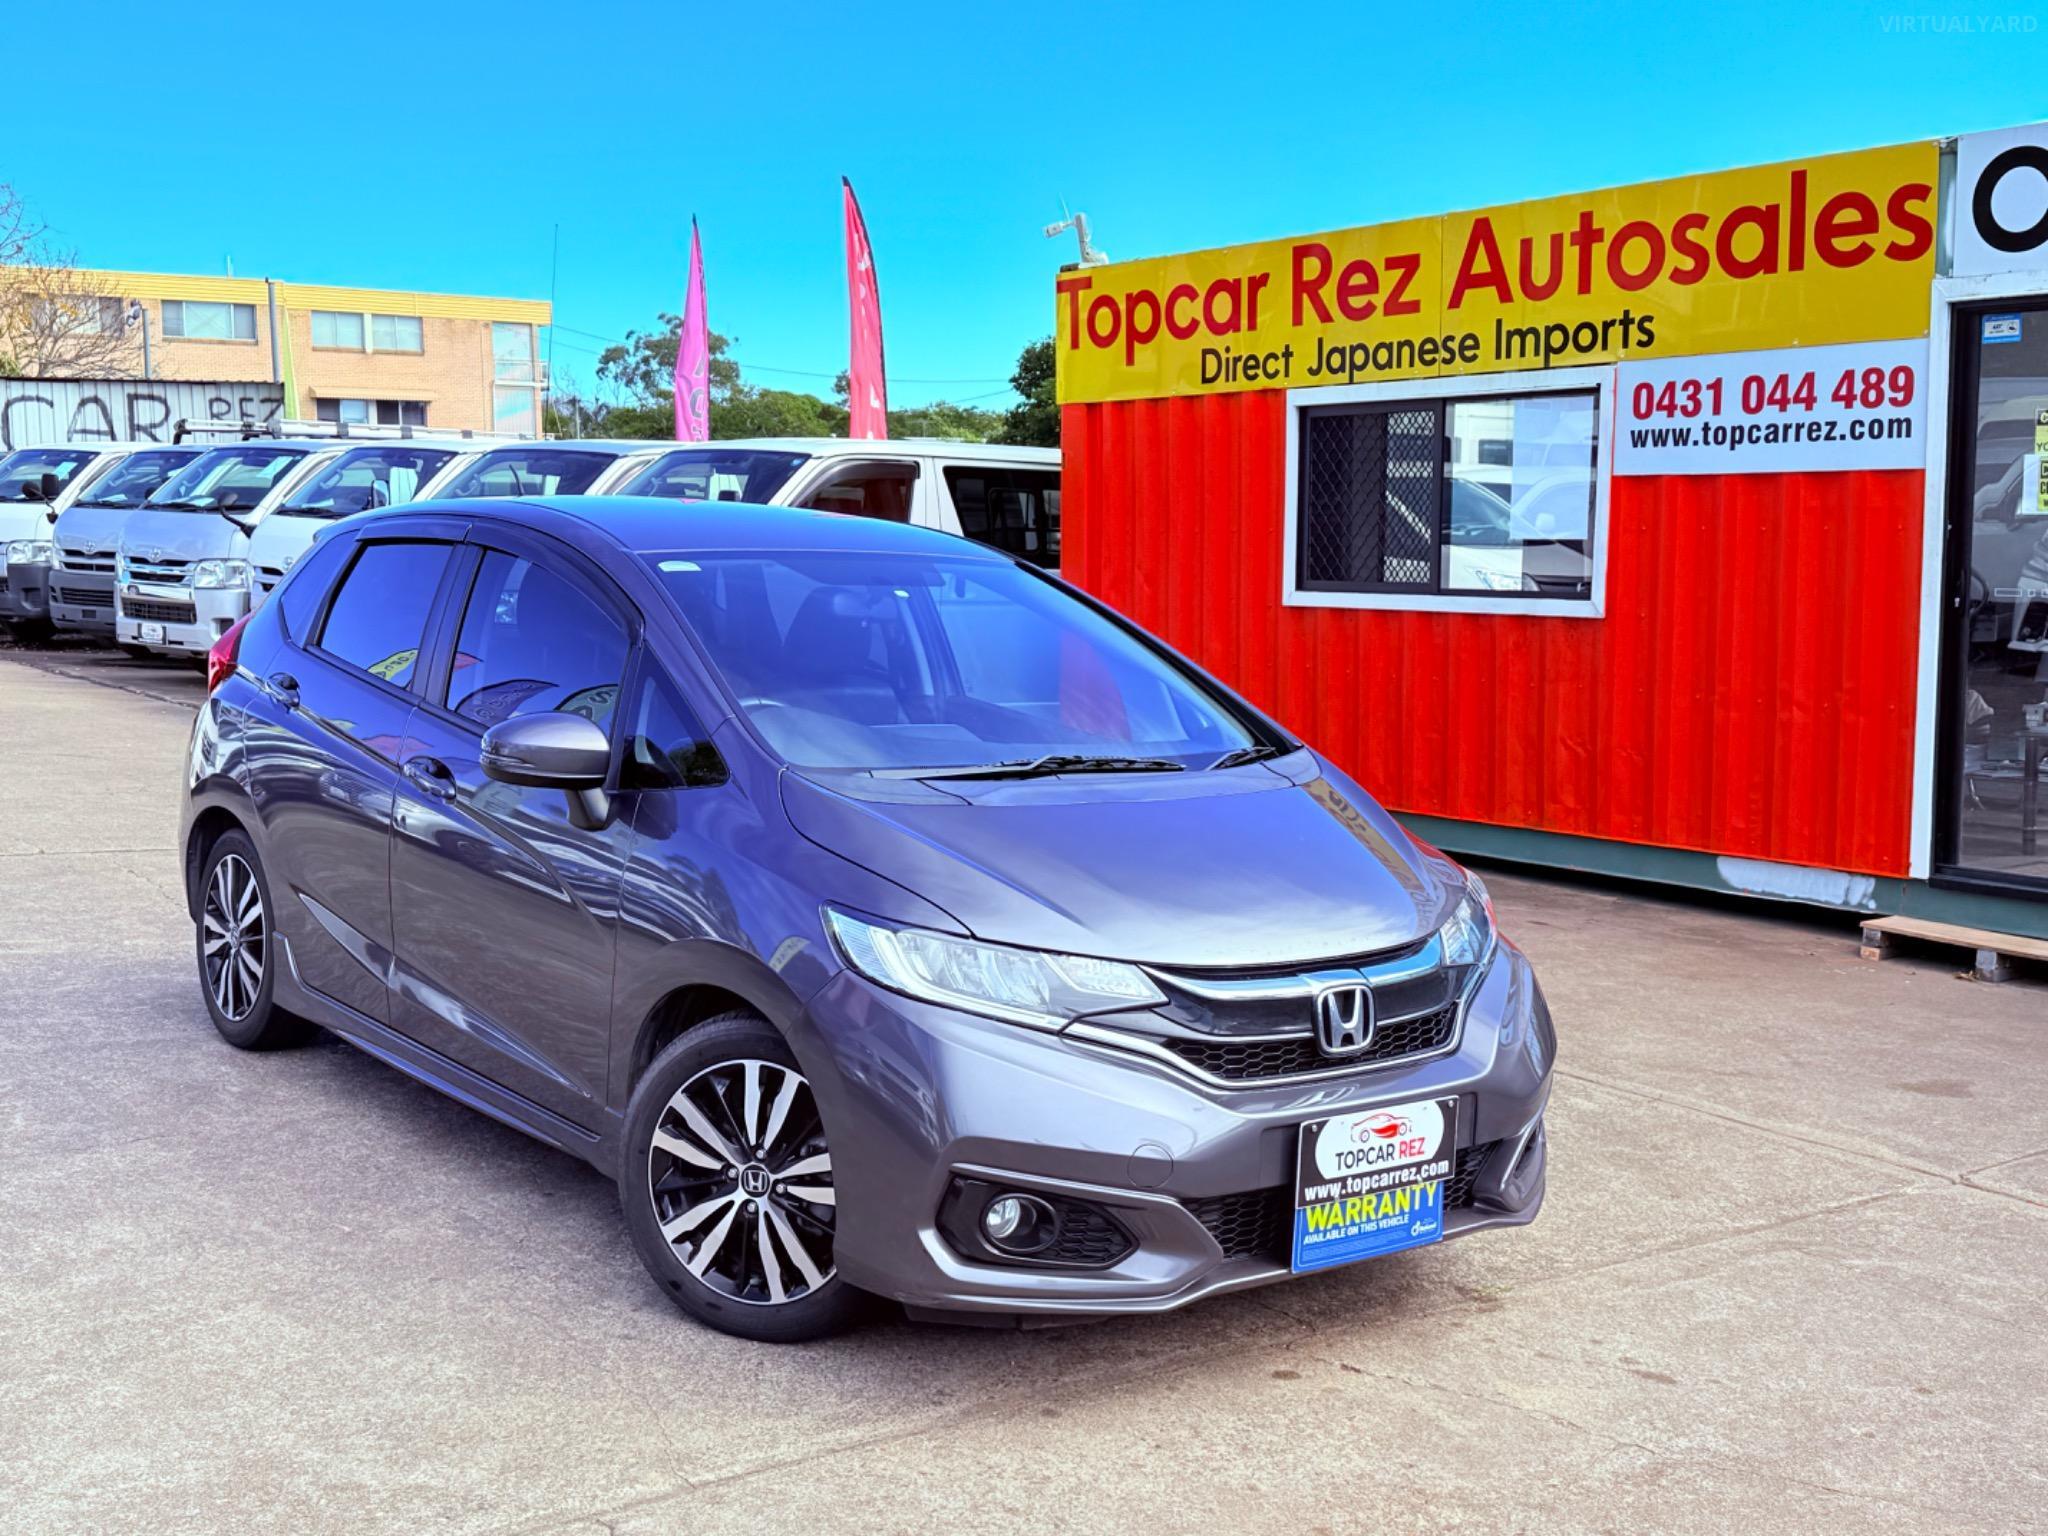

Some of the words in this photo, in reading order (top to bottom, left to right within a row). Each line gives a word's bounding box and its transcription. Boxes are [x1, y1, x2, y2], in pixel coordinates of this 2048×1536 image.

[1056, 272, 1271, 367] Topcar
[1291, 242, 1421, 327] Rez
[1446, 168, 1935, 311] Autosales
[1200, 343, 1294, 385] Direct
[1306, 331, 1481, 383] Japanese
[1494, 308, 1655, 367] Imports
[1632, 376, 1723, 420] 0431
[1741, 371, 1818, 415] 044
[1831, 365, 1915, 410] 489
[1, 393, 171, 450] CAR
[1630, 416, 1913, 451] www.topcarrez.com
[1304, 1160, 1449, 1201] www.topcarrez.com
[1335, 1143, 1395, 1171] TOPCAR
[1398, 1137, 1426, 1159] REZ
[1303, 1228, 1346, 1245] AVAILABLE
[1347, 1225, 1360, 1236] ON
[1360, 1221, 1378, 1233] THIS
[1378, 1214, 1410, 1229] VEHICLE
[1305, 1180, 1437, 1233] WARRANTY
